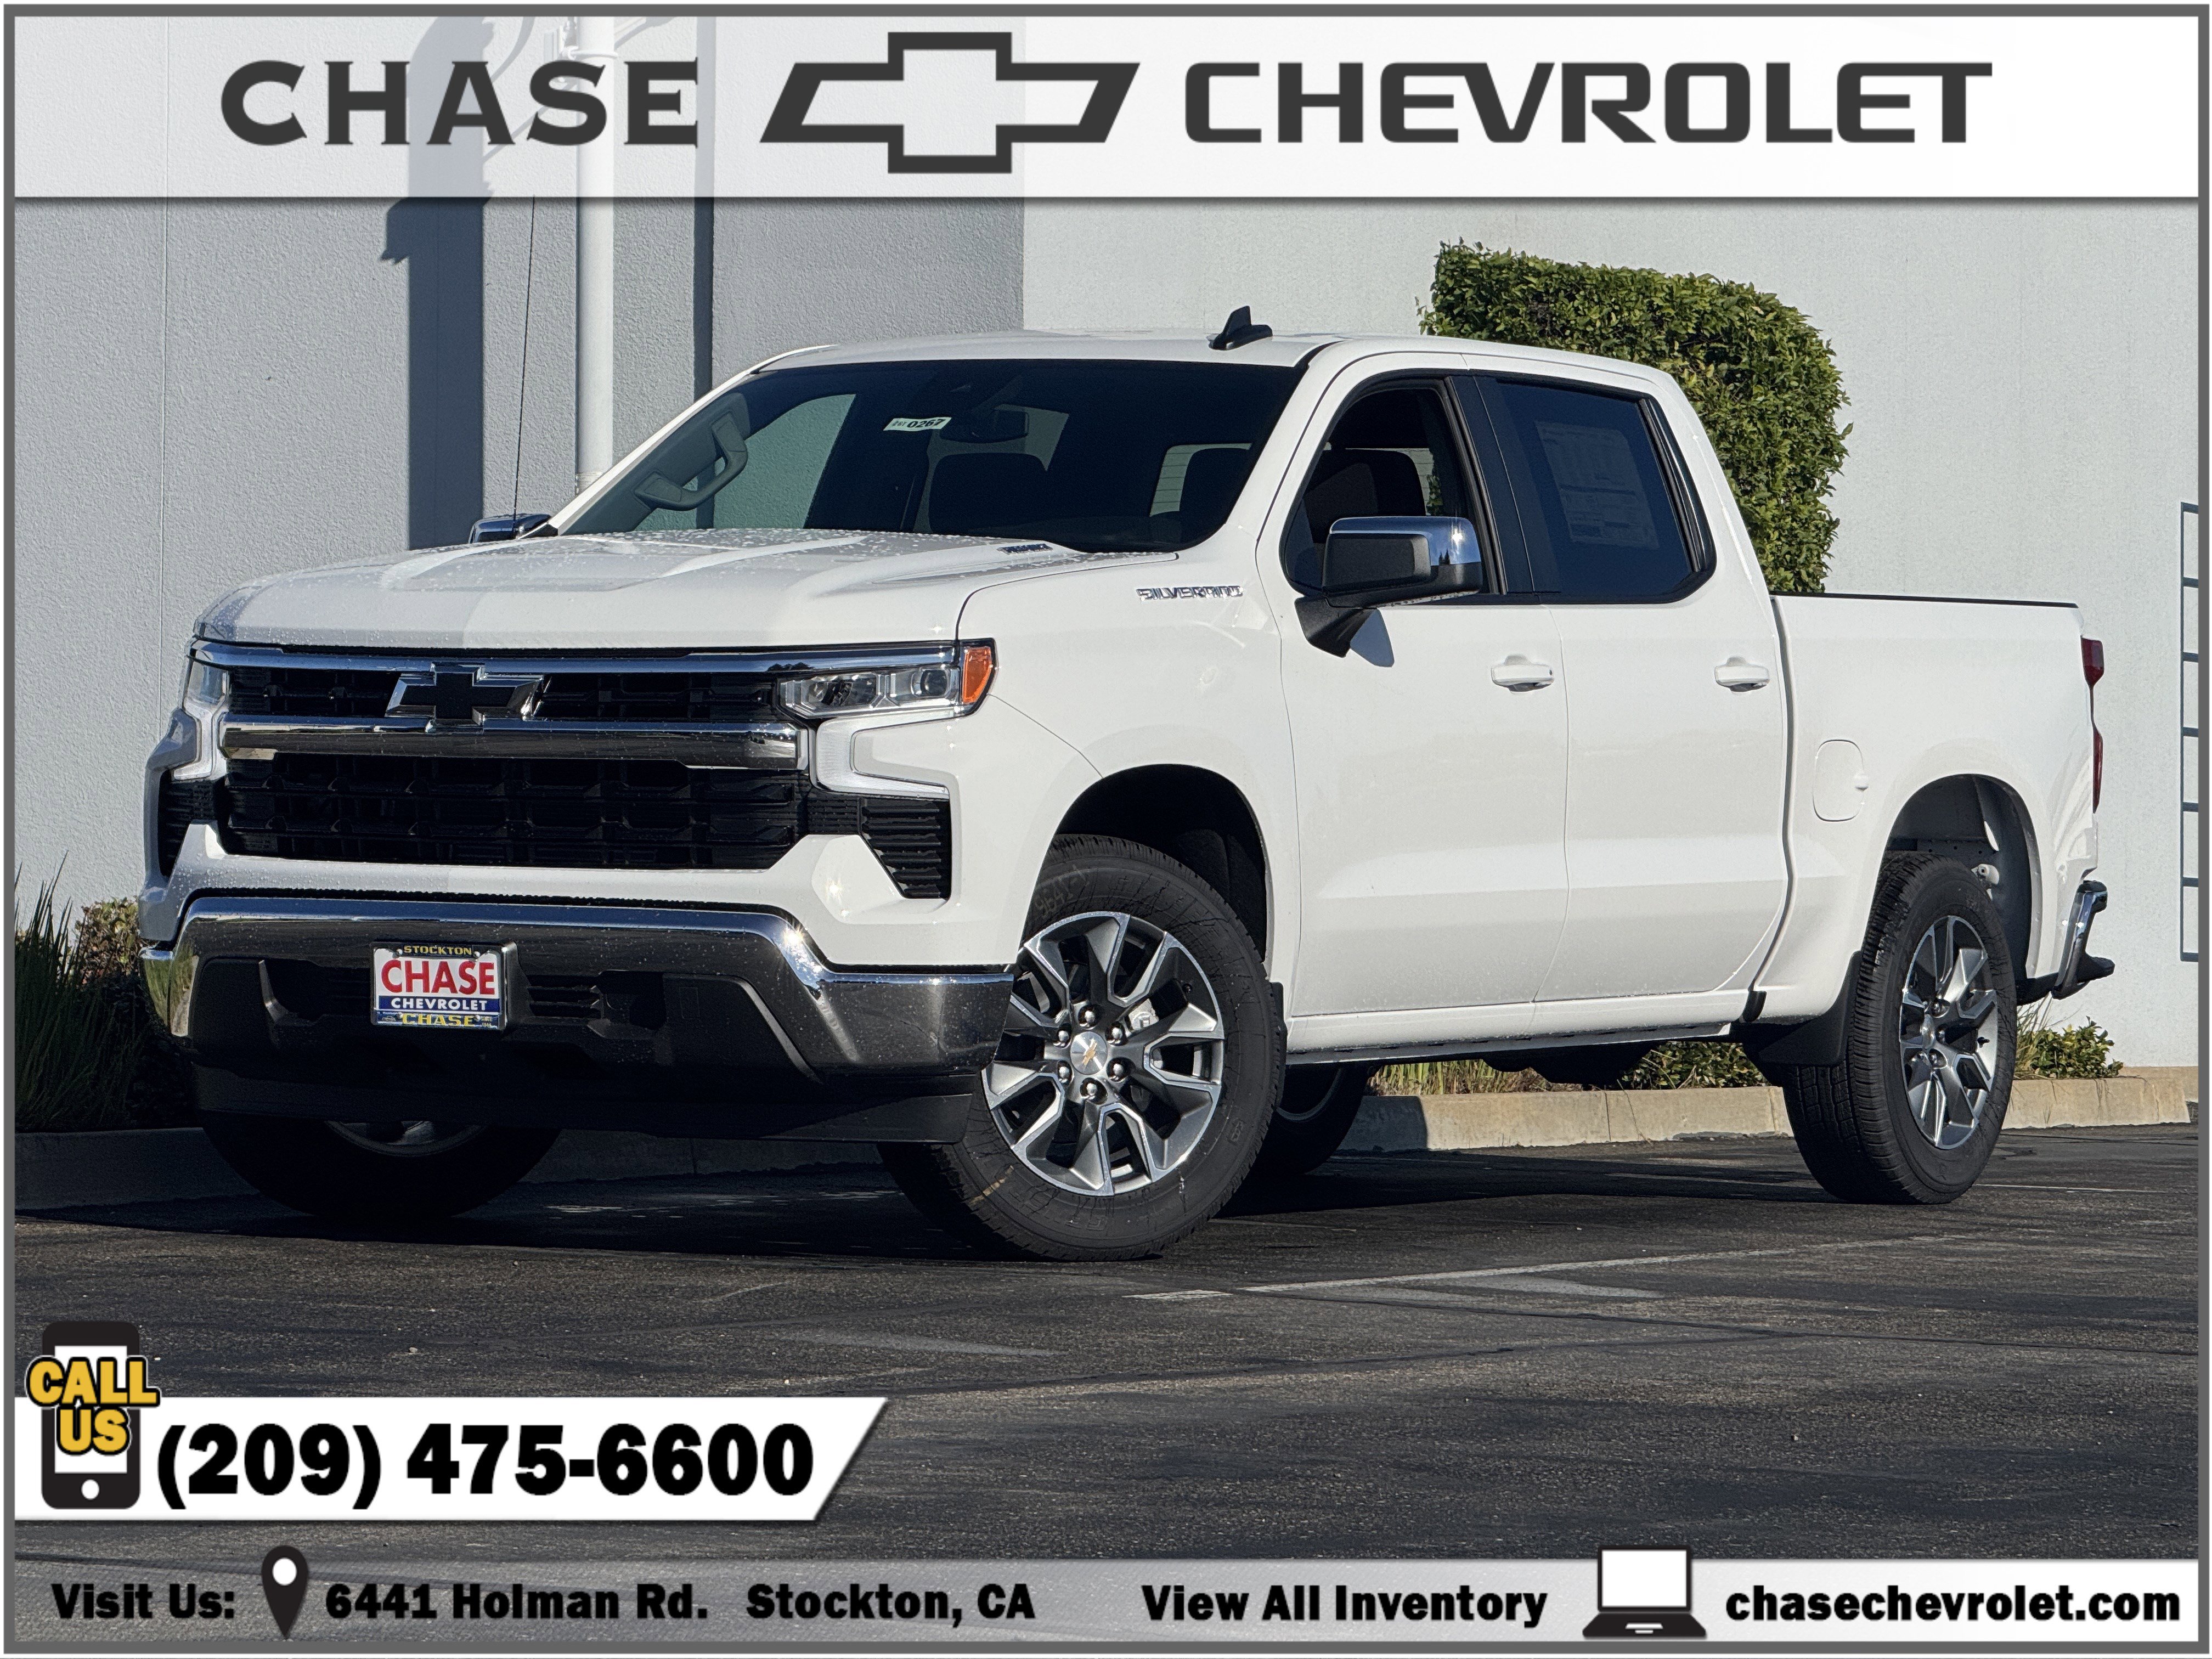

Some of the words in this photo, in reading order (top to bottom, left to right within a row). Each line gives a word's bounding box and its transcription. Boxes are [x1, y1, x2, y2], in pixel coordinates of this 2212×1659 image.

[907, 419, 946, 428] 0267
[404, 945, 472, 955] STOCKTON
[381, 960, 495, 995] CHASE
[391, 998, 487, 1011] CHEVROLET
[402, 1013, 474, 1027] CHASE
